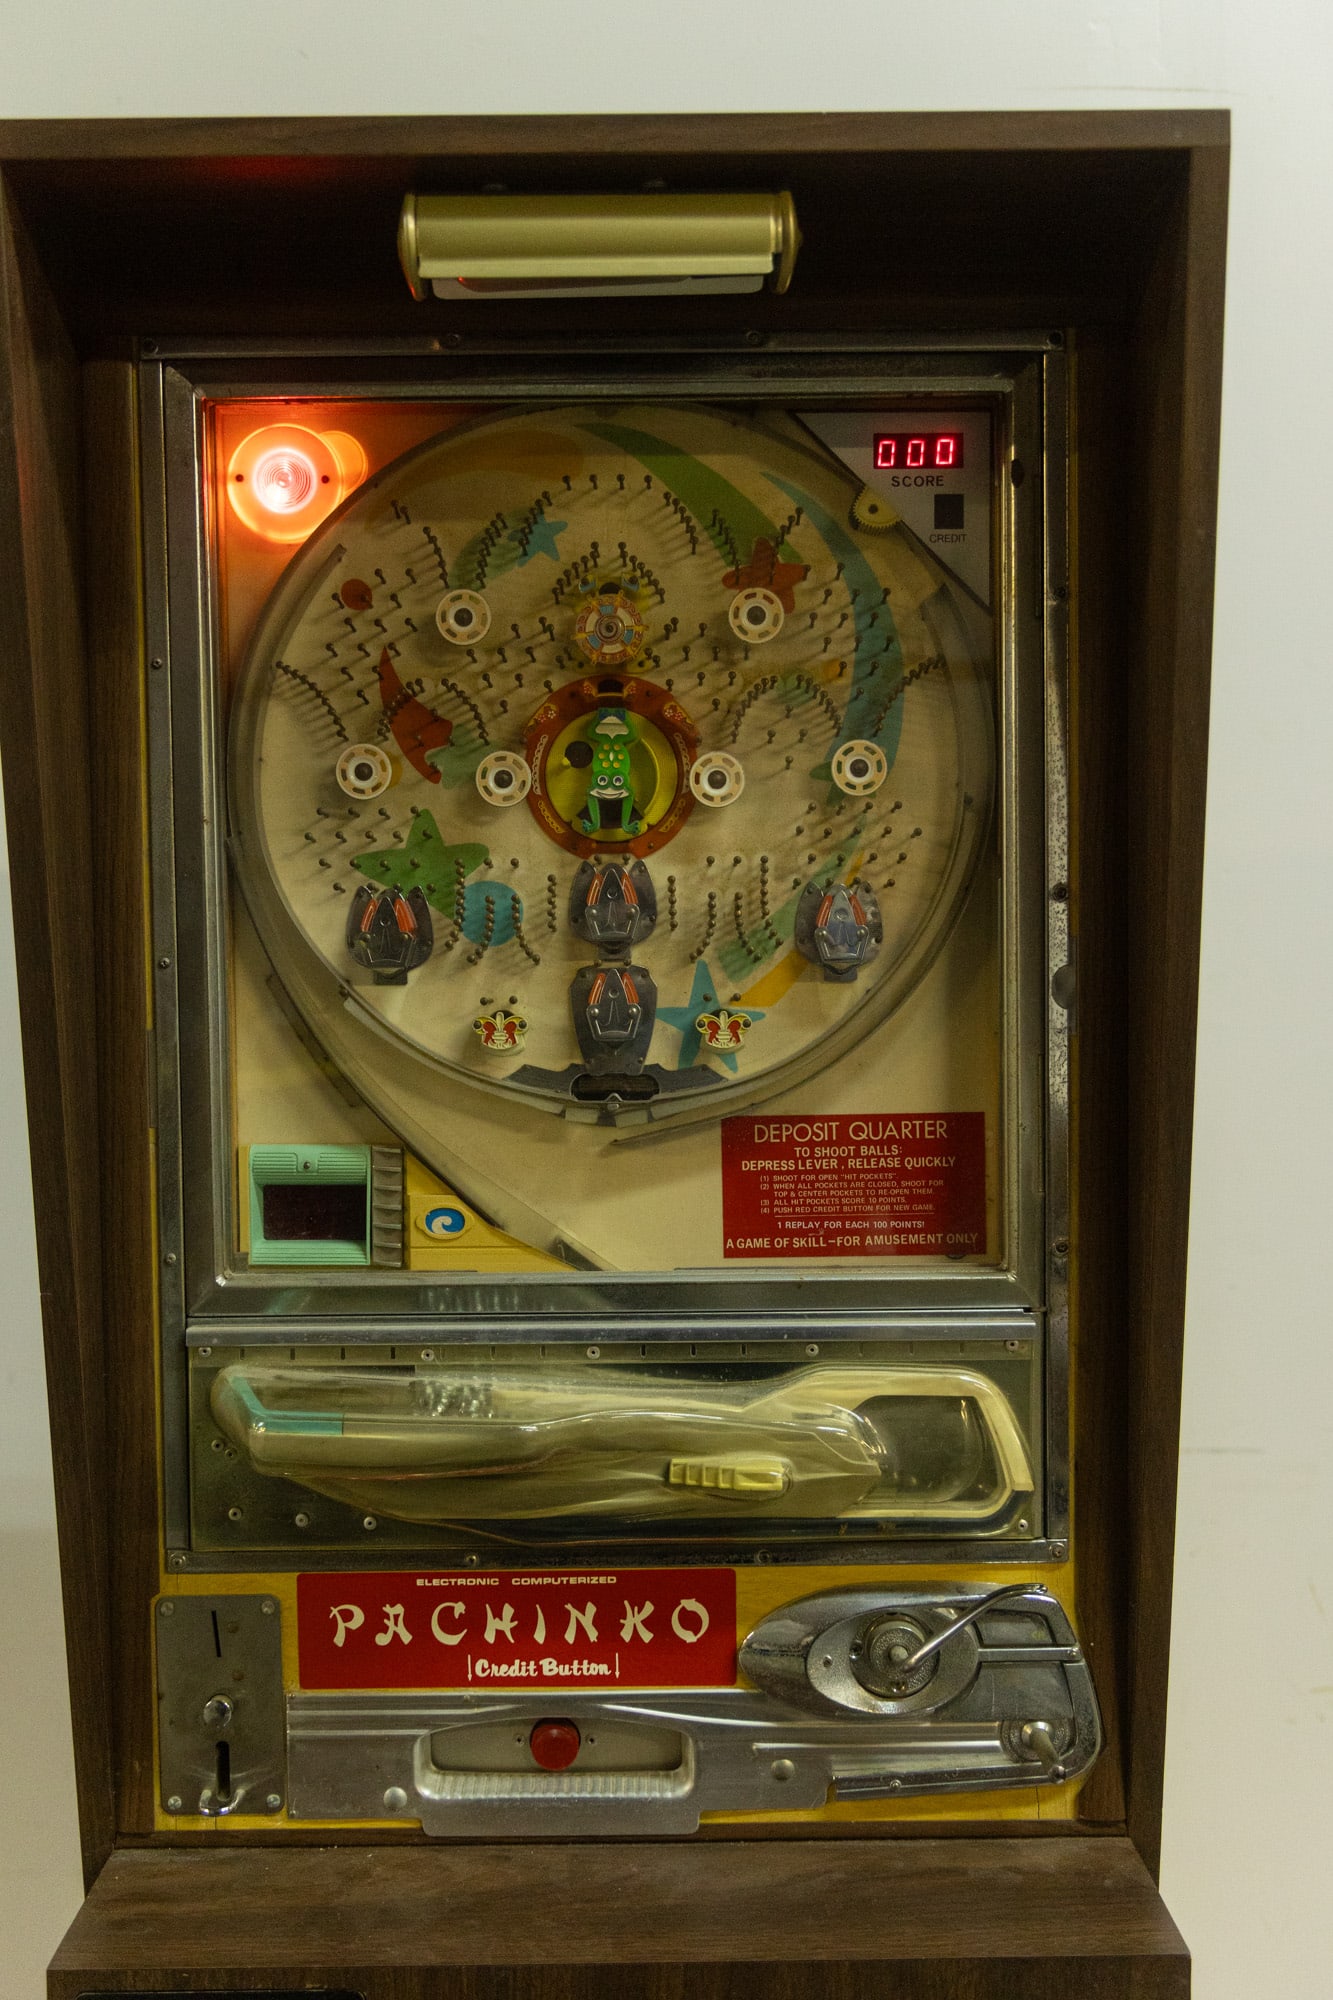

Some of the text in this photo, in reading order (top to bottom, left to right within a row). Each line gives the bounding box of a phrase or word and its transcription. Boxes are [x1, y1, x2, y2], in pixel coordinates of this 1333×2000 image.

[877, 438, 954, 467] 000
[891, 475, 945, 487] SCORE
[929, 533, 967, 544] CREDIT
[754, 1120, 948, 1143] DEPOSIT QUARTER
[793, 1144, 903, 1158] TO SHOOT BALLS:
[741, 1159, 796, 1171] DEPRESS
[847, 1157, 901, 1169] RELEASE
[904, 1156, 956, 1170] QUICKLY
[773, 1174, 798, 1182] SHOOT
[814, 1181, 848, 1189] POCKETS
[867, 1180, 899, 1188] CLOSED,
[774, 1190, 788, 1198] TOP
[829, 1189, 863, 1197] POCKETS
[878, 1188, 910, 1196] RE-OPEN
[806, 1197, 839, 1205] POCKETS
[773, 1206, 793, 1214] PUSH
[813, 1205, 840, 1213] CREDIT
[777, 1220, 925, 1229] 1 REPLAY FOR EACH 100 POINTS!
[726, 1238, 735, 1249] A
[736, 1238, 771, 1249] GAME
[774, 1238, 790, 1248] OF
[864, 1233, 944, 1246] AMUSEMENT
[946, 1232, 978, 1244] ONLY
[416, 1576, 617, 1587] ELECTRONIC COMPUTERIZED
[329, 1598, 710, 1648] PACHINKO
[475, 1657, 612, 1678] Credit Button
